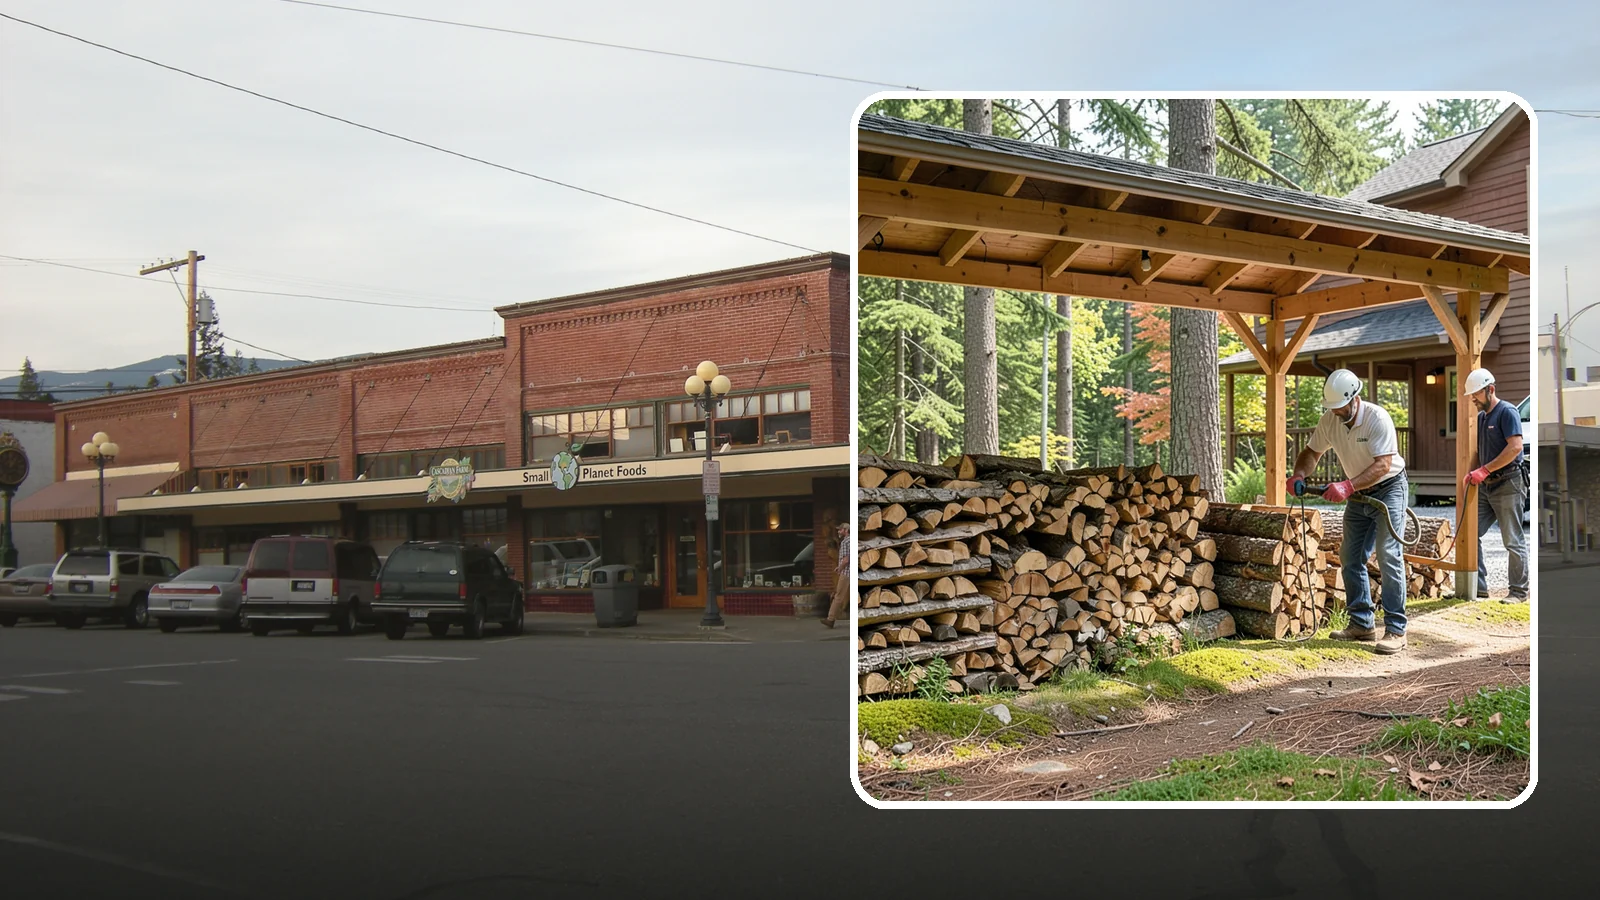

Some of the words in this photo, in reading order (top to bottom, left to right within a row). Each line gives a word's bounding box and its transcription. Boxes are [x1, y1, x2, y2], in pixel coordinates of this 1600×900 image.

[523, 471, 549, 483] Small
[583, 468, 614, 479] Planet
[617, 464, 647, 476] Foods
